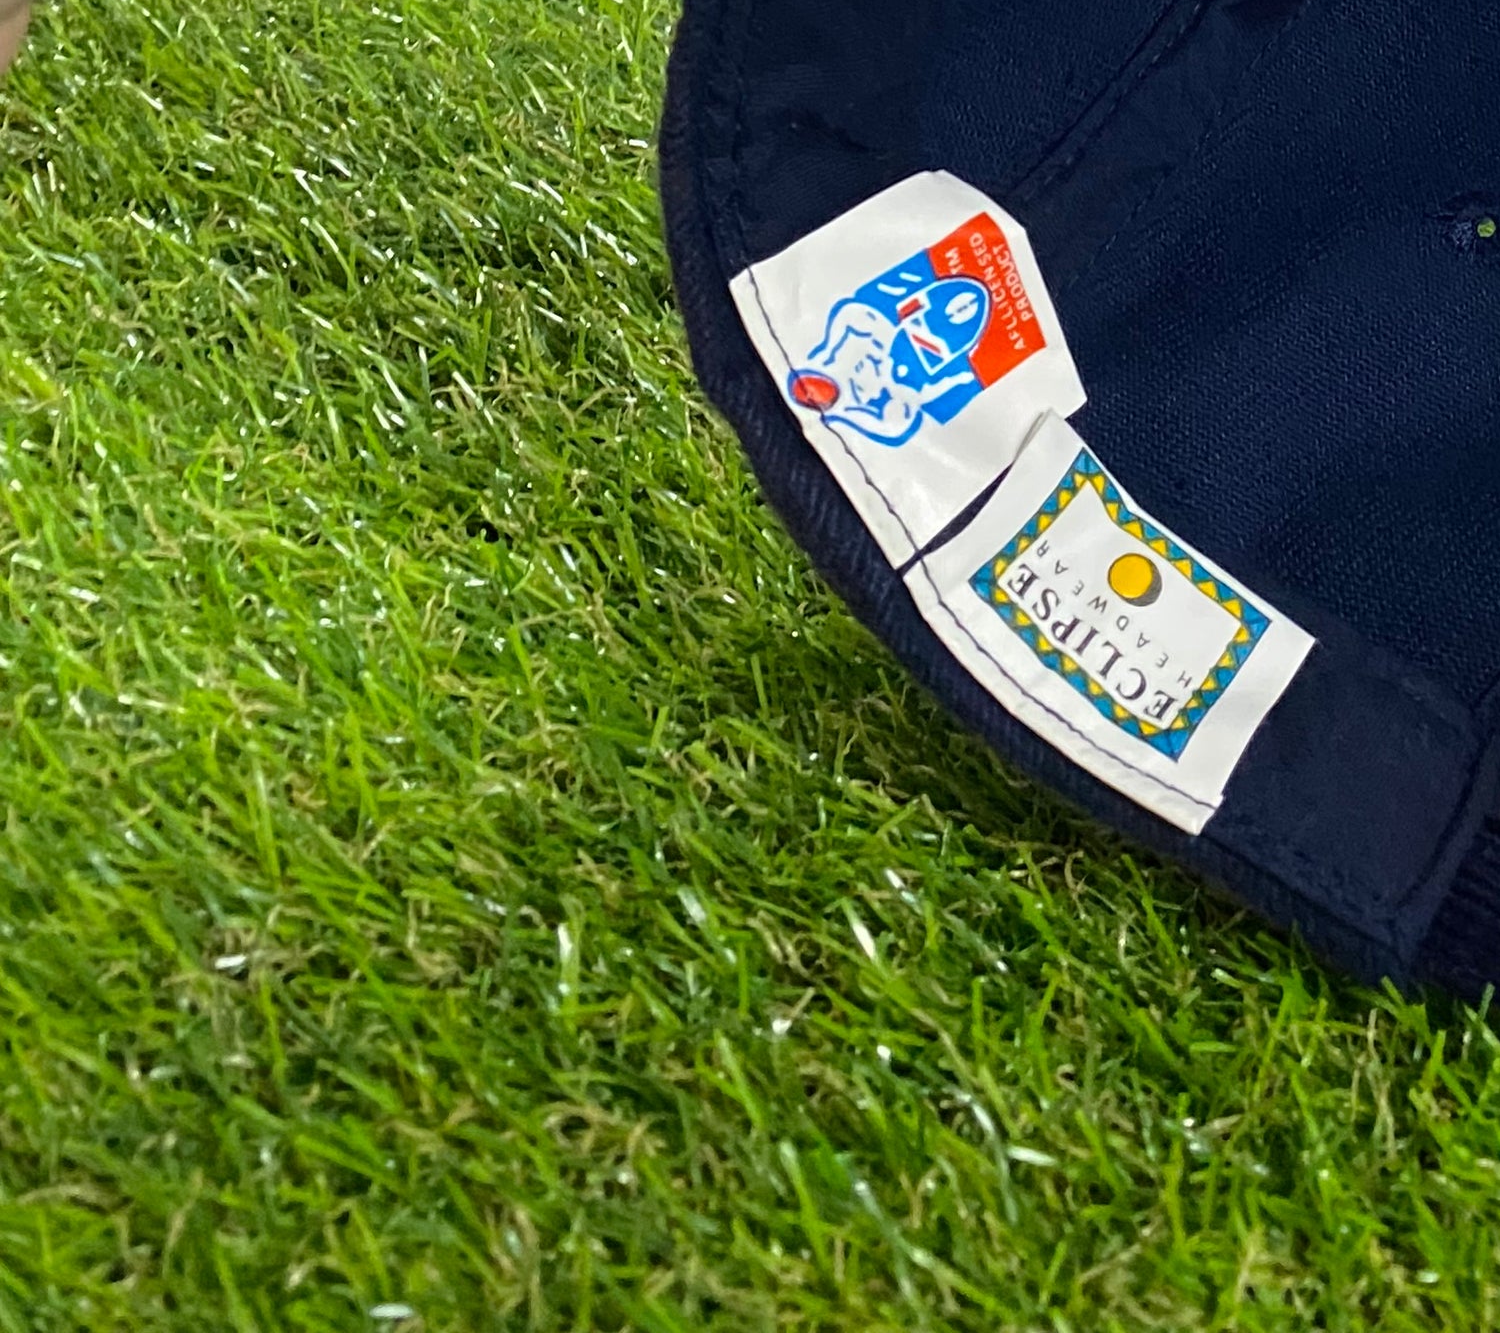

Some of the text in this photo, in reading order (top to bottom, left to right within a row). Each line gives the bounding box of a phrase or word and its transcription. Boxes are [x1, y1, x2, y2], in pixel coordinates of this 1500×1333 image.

[944, 246, 966, 276] TM
[991, 242, 1034, 323] PRODUCT
[1007, 562, 1178, 721] ECLIPSE
[1035, 539, 1193, 689] HEADWEAR
